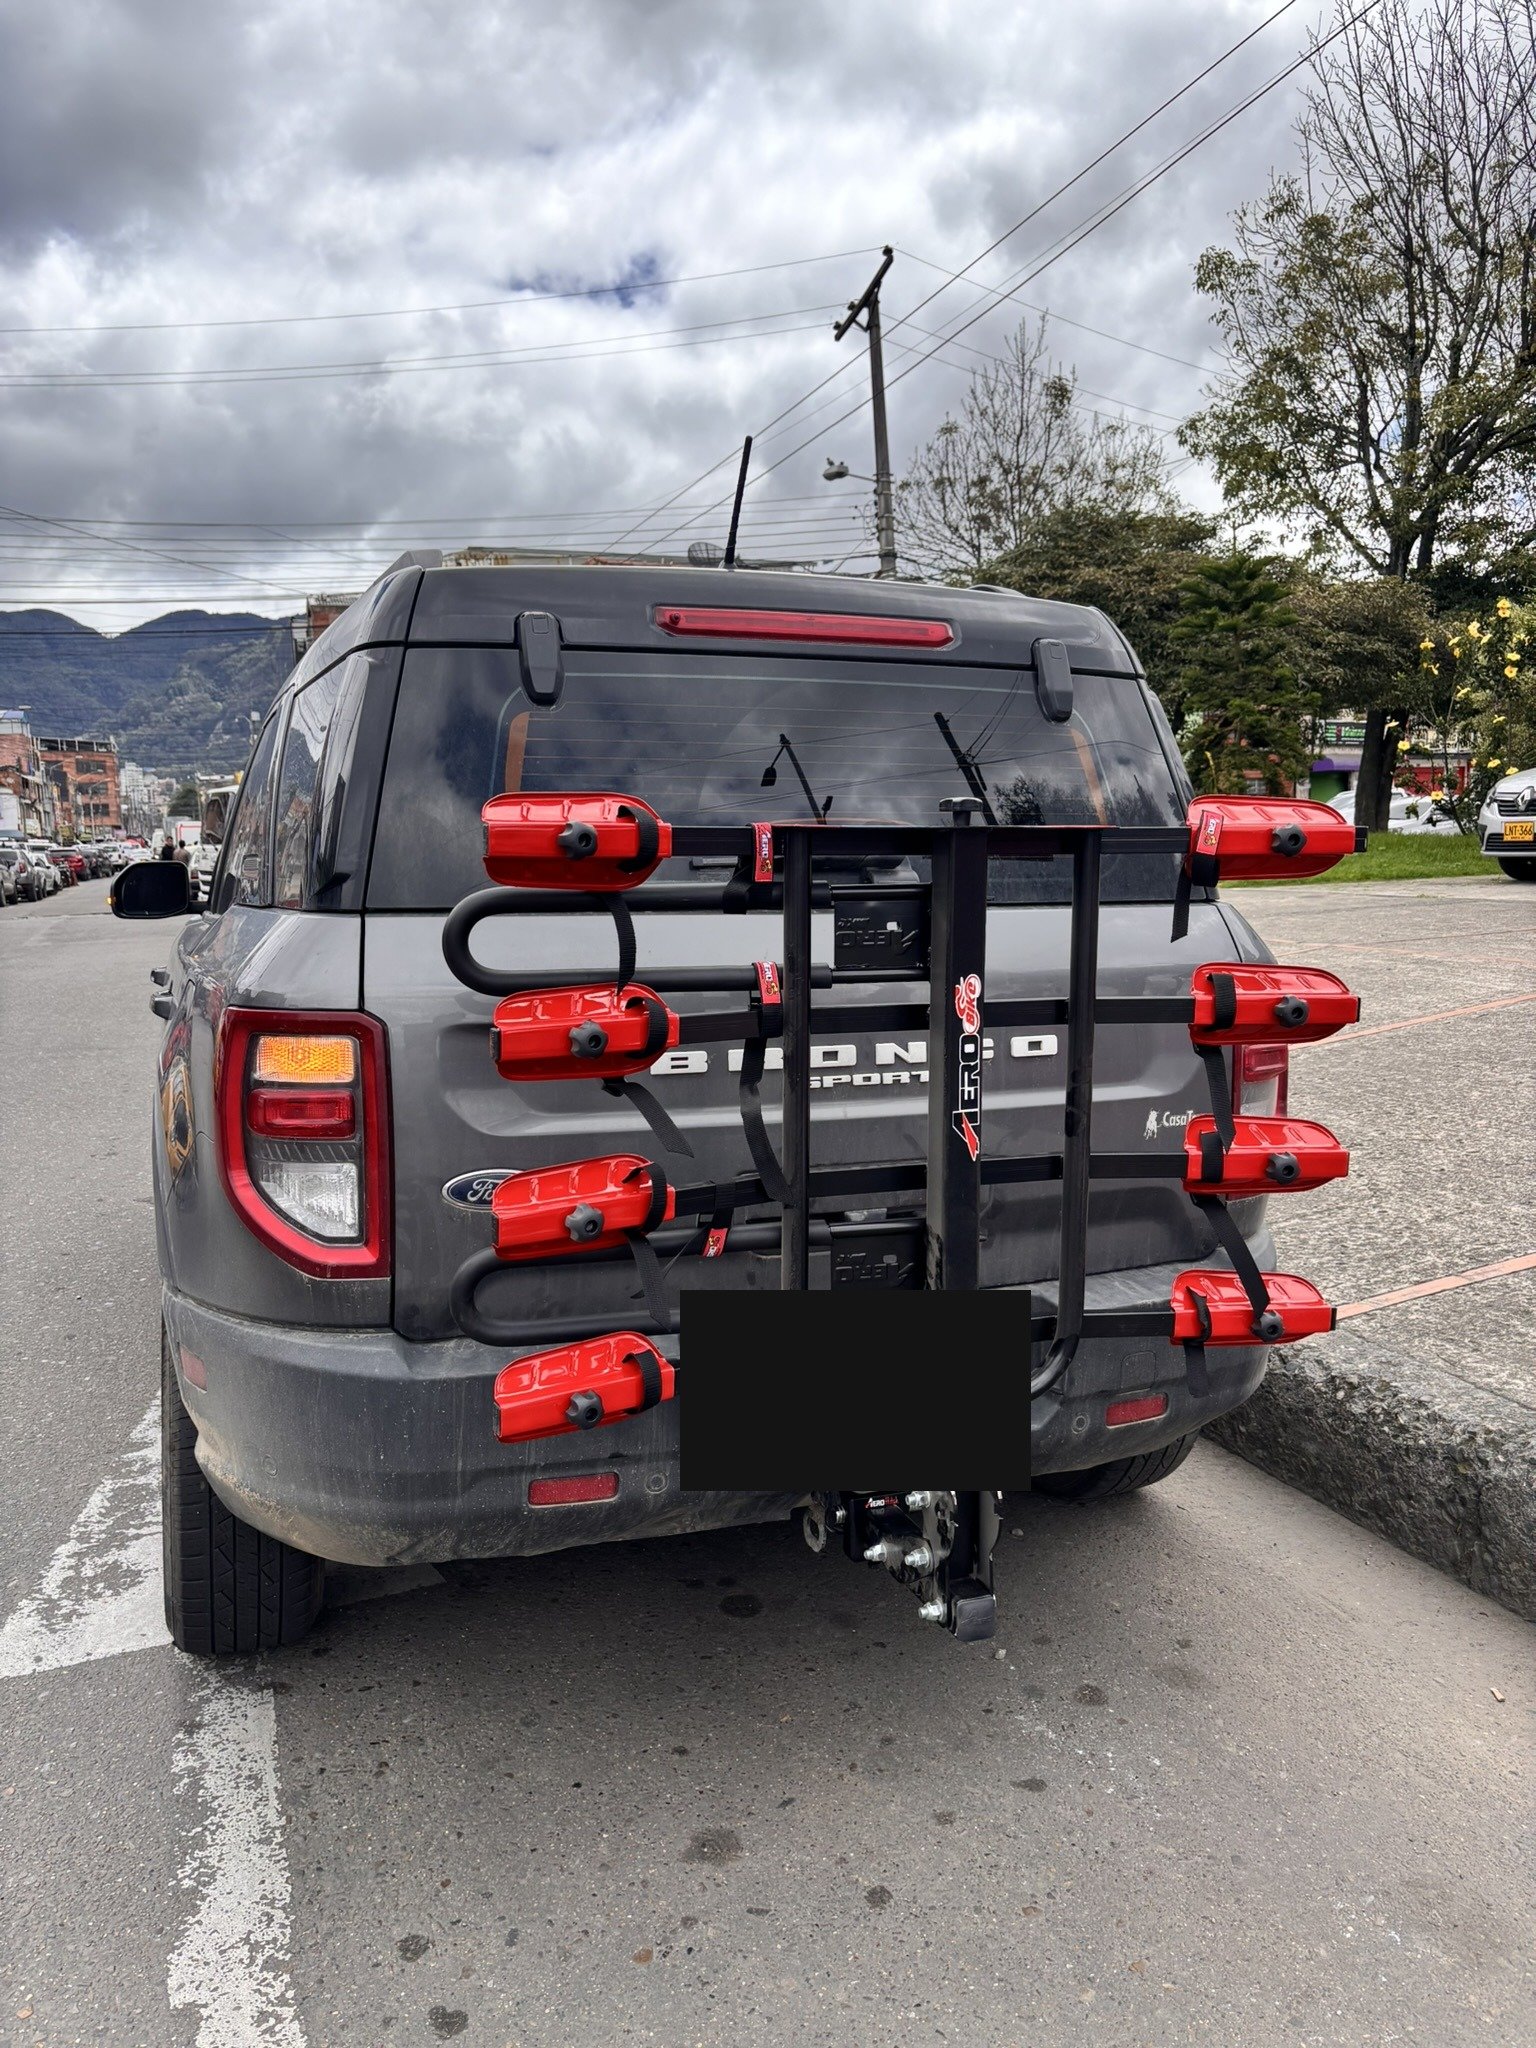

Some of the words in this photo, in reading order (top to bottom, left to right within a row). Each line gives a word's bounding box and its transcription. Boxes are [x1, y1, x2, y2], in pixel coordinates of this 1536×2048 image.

[650, 1034, 1058, 1075] BRONO
[952, 1033, 980, 1161] AERO
[1162, 1109, 1197, 1127] CasaT
